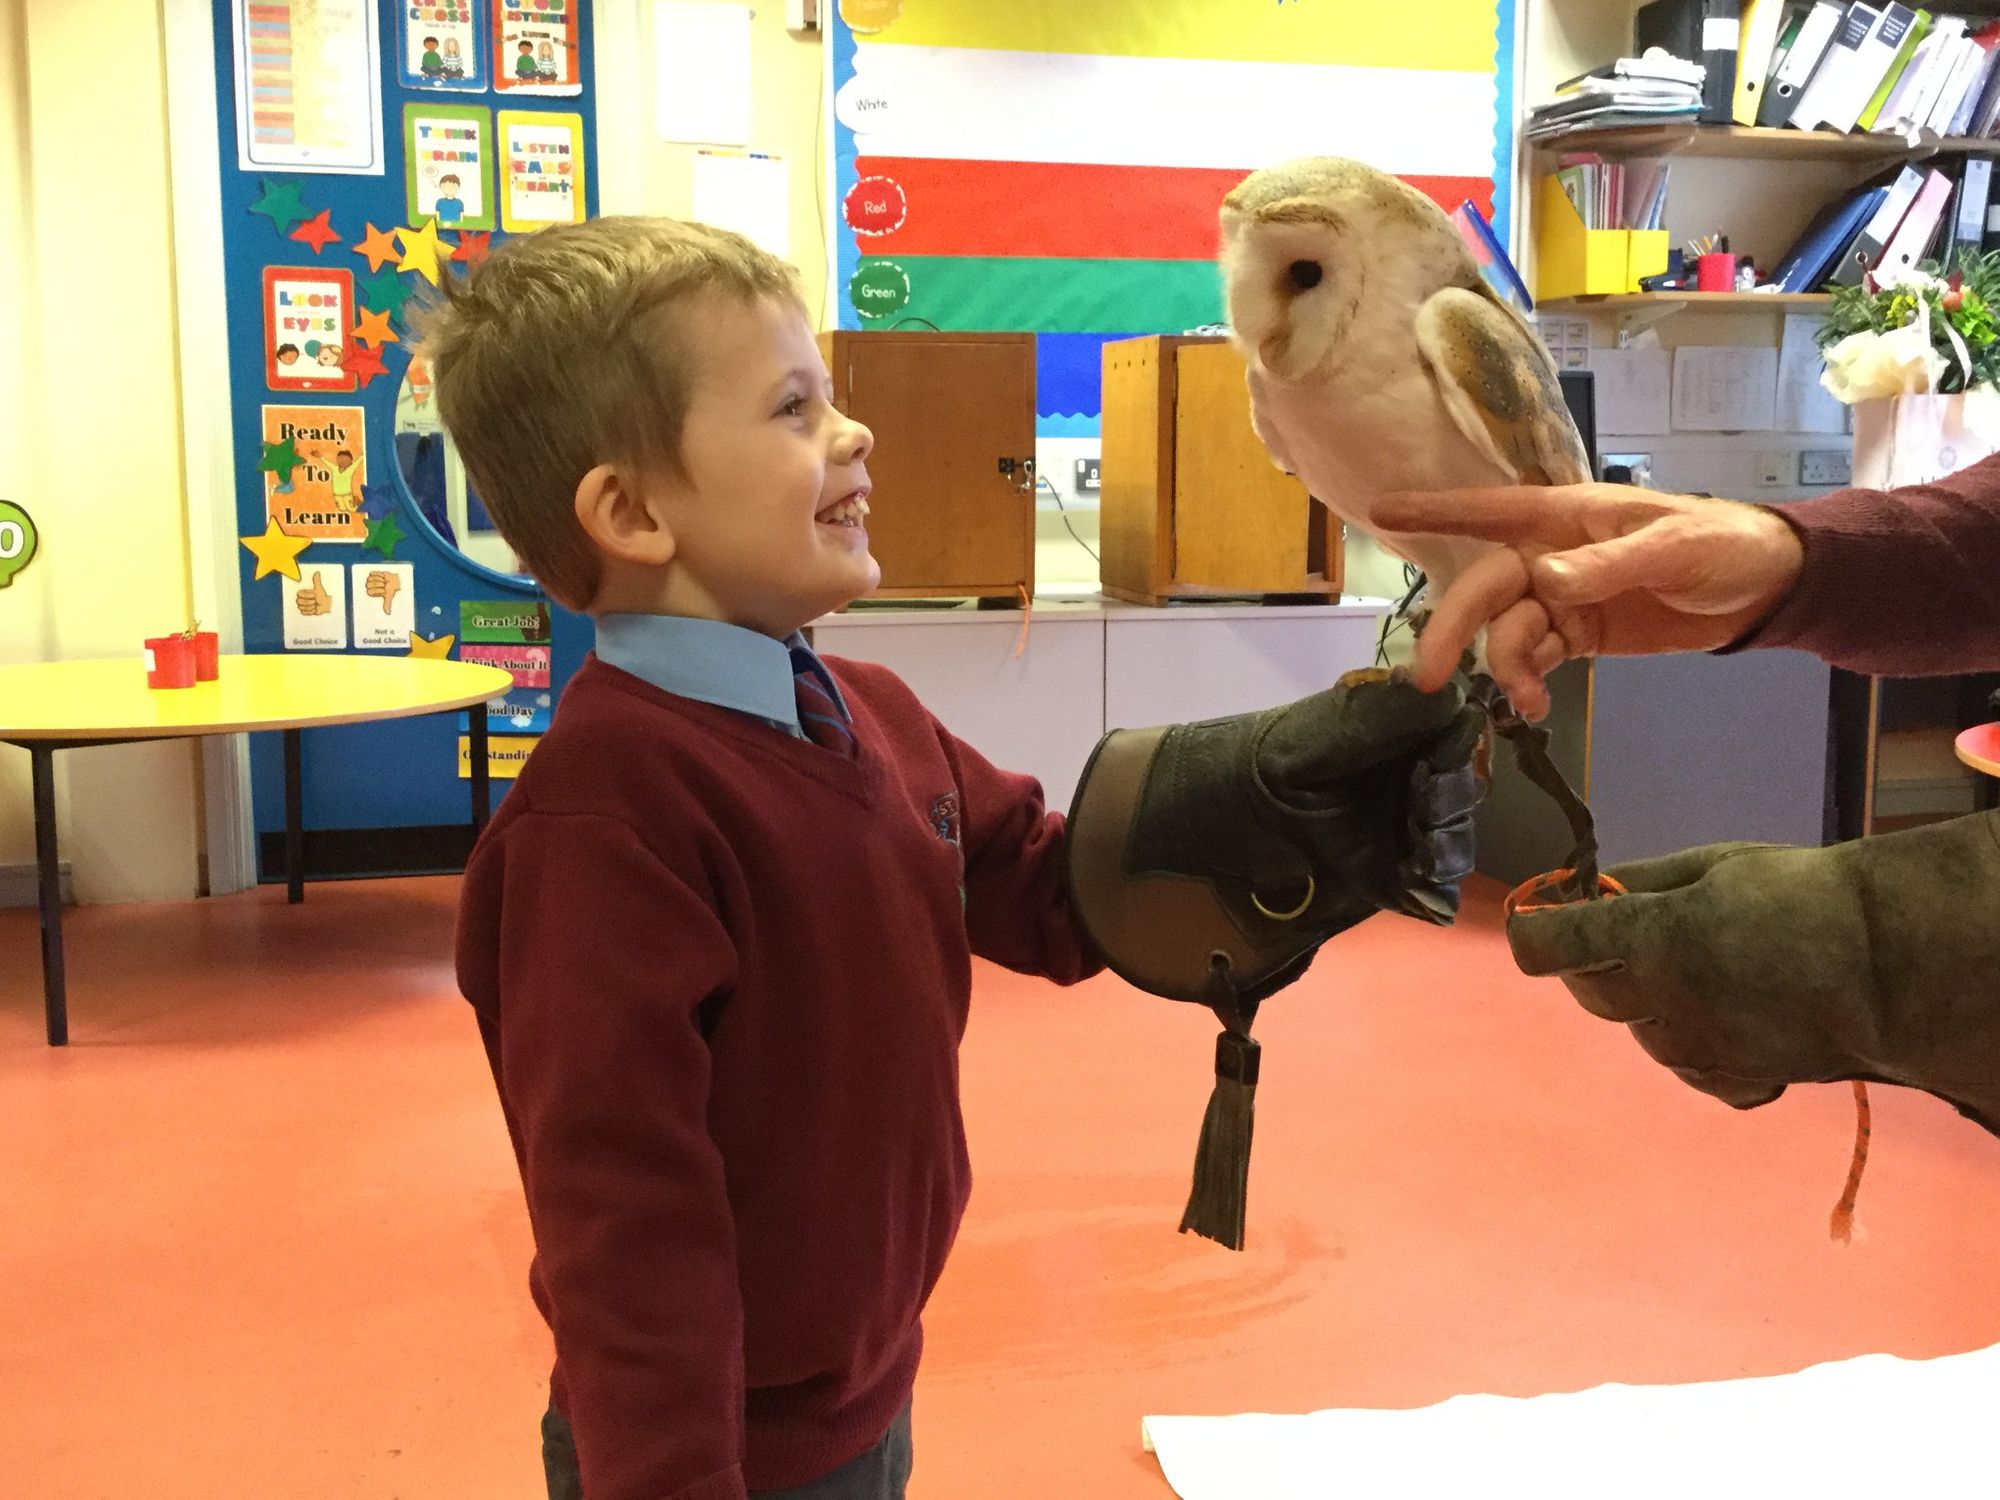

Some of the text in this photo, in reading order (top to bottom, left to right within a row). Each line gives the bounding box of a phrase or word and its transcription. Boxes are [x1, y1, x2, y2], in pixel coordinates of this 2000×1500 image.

[410, 7, 470, 23] CROSS
[856, 99, 889, 111] White
[418, 126, 477, 140] THINK
[512, 141, 570, 154] LISTEN
[864, 200, 887, 215] Red
[861, 283, 897, 299] Green
[279, 291, 338, 308] LOOK
[283, 316, 337, 332] EYES
[281, 423, 348, 446] Ready
[302, 465, 331, 482] To
[285, 507, 351, 524] Learn
[473, 614, 510, 628] Great
[292, 637, 338, 645] Good Choice
[362, 637, 407, 645] Good Choice
[503, 659, 535, 670] About
[539, 660, 548, 669] It
[511, 704, 534, 718] Day
